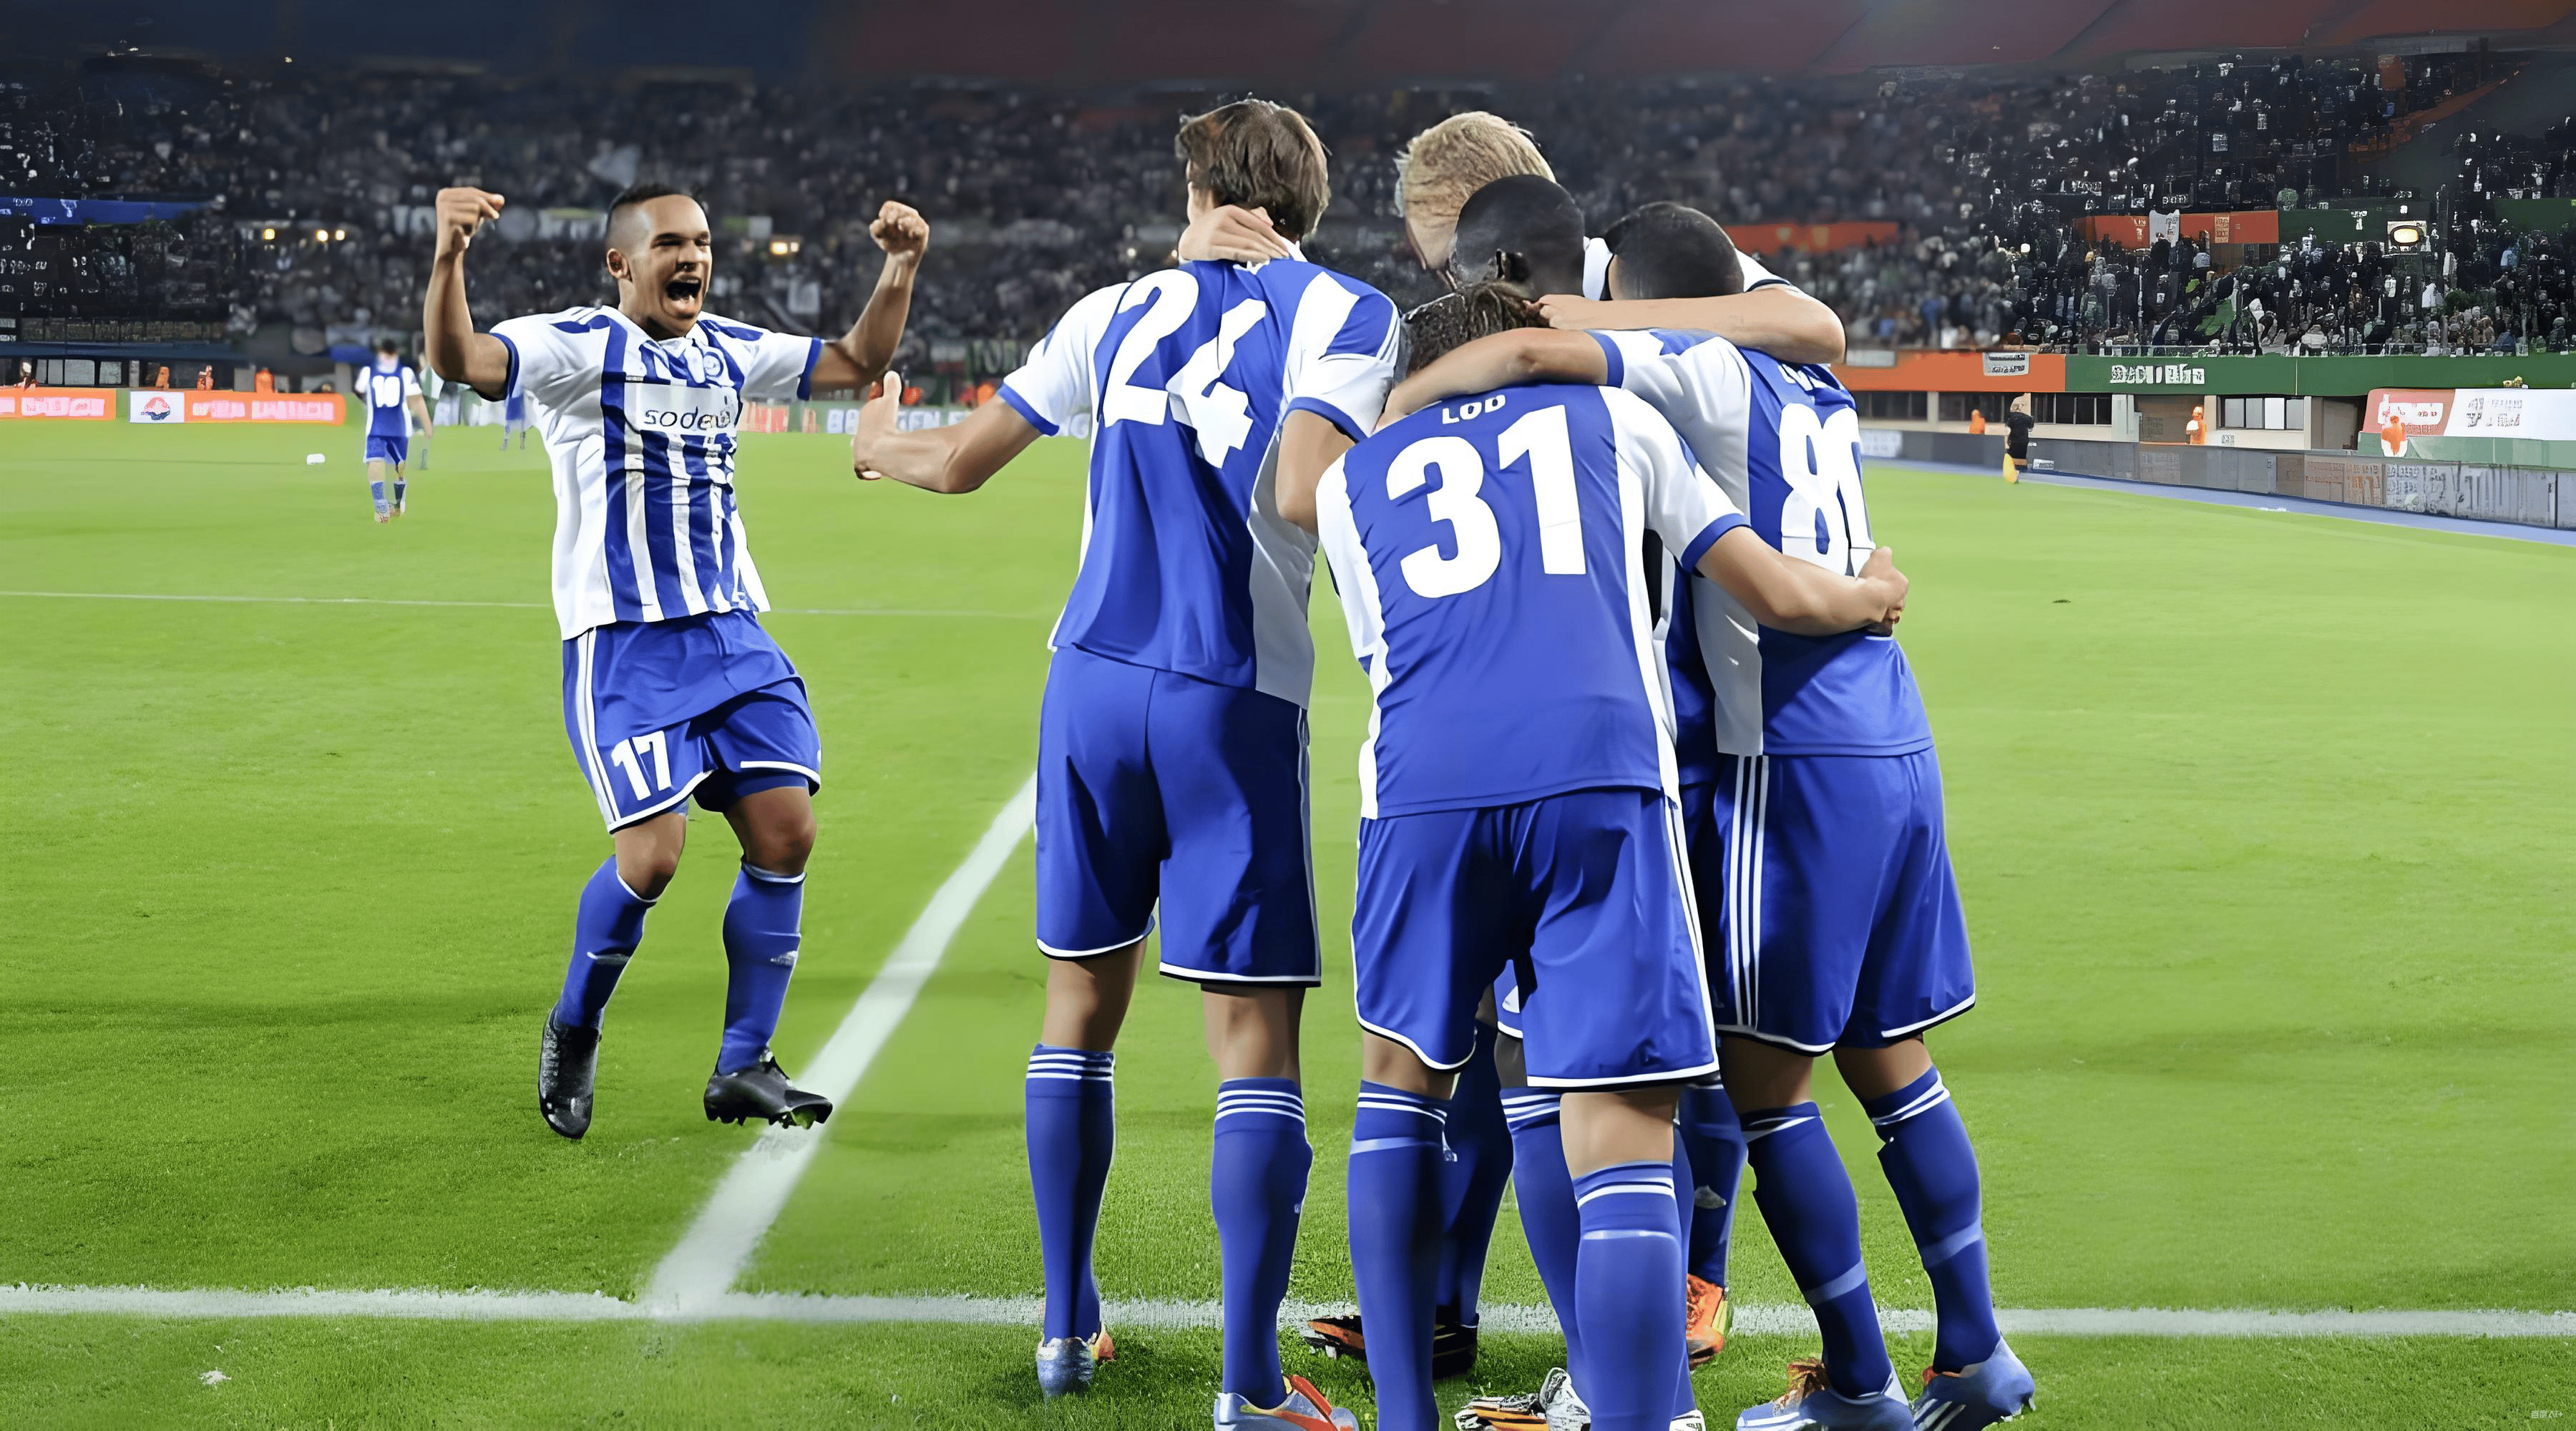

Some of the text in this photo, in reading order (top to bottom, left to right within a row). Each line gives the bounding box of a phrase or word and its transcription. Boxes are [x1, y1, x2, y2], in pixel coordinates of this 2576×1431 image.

[1103, 269, 1267, 469] 24
[1442, 394, 1506, 424] LOD
[1386, 404, 1586, 598] 31
[611, 731, 672, 801] 17
